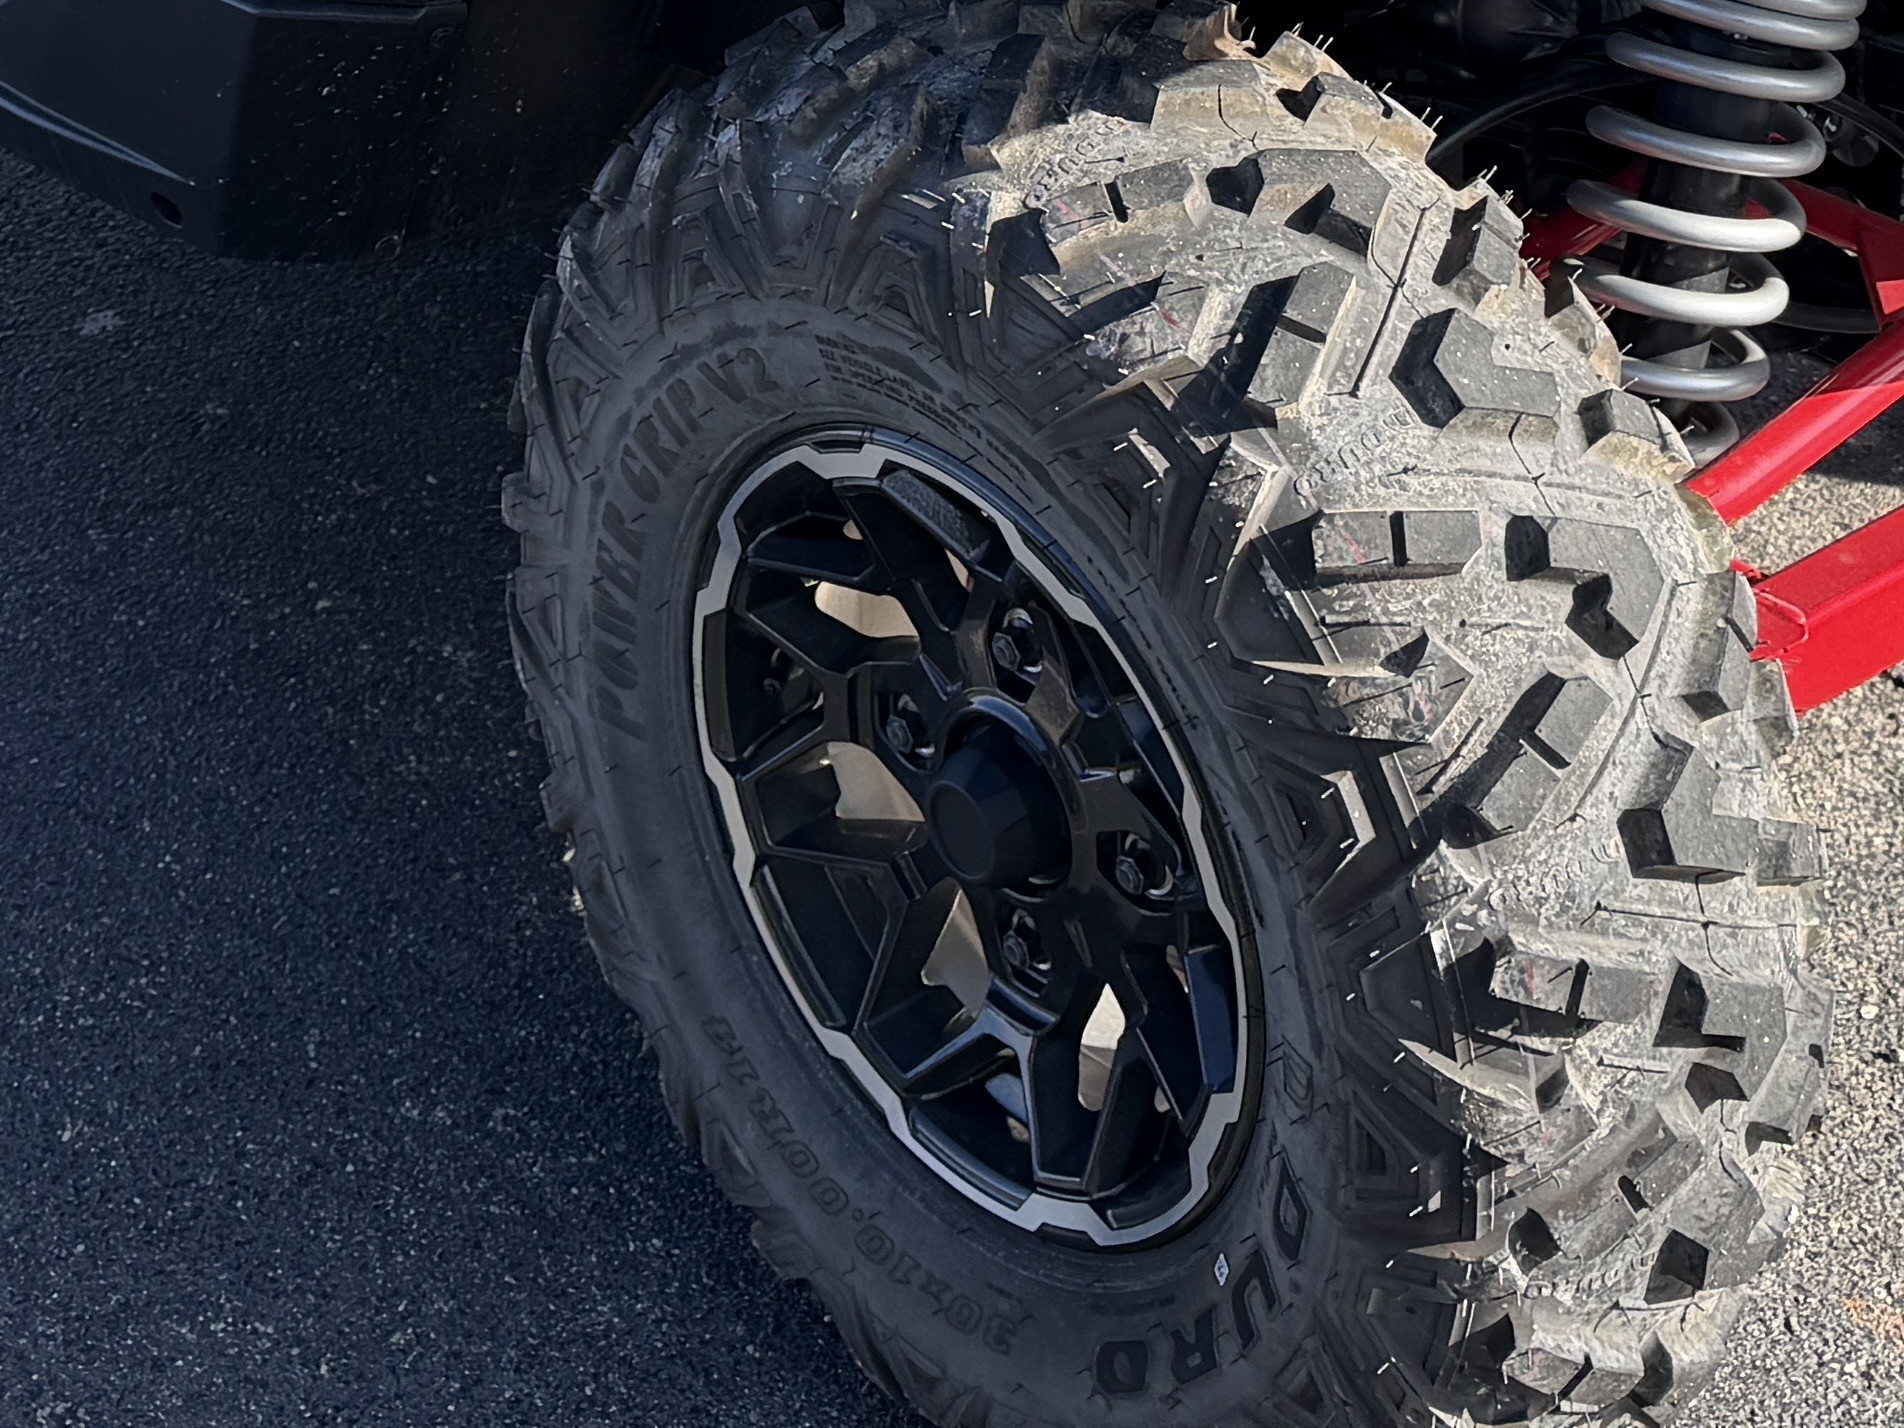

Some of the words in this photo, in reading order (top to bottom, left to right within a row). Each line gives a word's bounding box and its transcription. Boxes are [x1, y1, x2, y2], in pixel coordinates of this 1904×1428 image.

[619, 370, 707, 505] GRIP
[697, 347, 782, 405] V2
[590, 500, 650, 744] POWER
[1094, 1152, 1309, 1396] DURO
